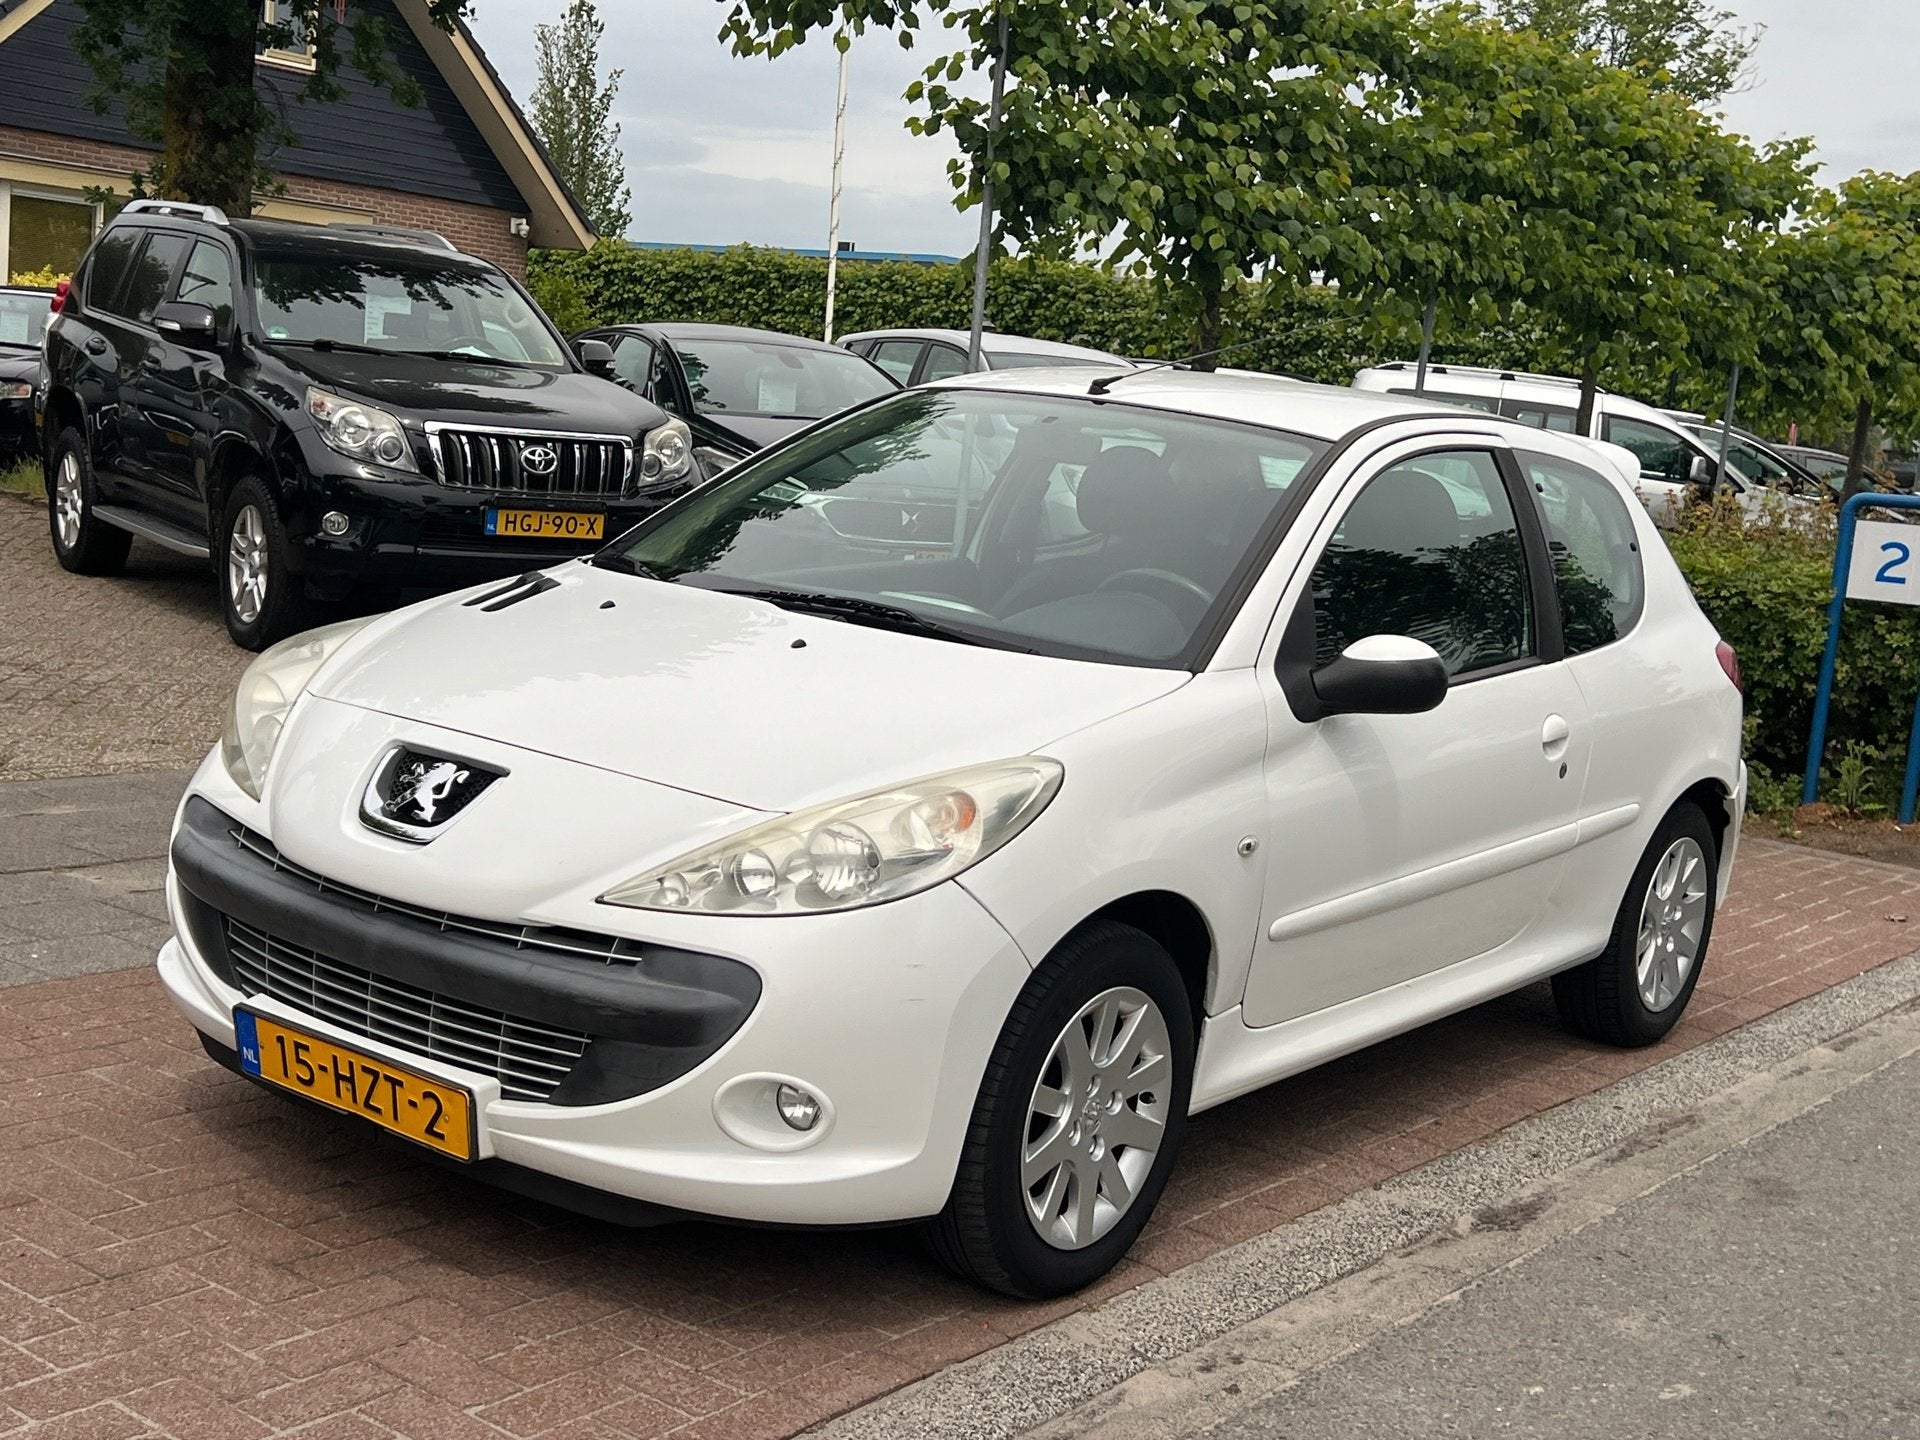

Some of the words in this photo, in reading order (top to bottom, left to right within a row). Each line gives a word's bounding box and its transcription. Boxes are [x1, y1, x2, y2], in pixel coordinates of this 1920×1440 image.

[1875, 541, 1910, 585] 2
[243, 1046, 258, 1065] NL
[275, 1034, 447, 1142] 15-HZT-2
